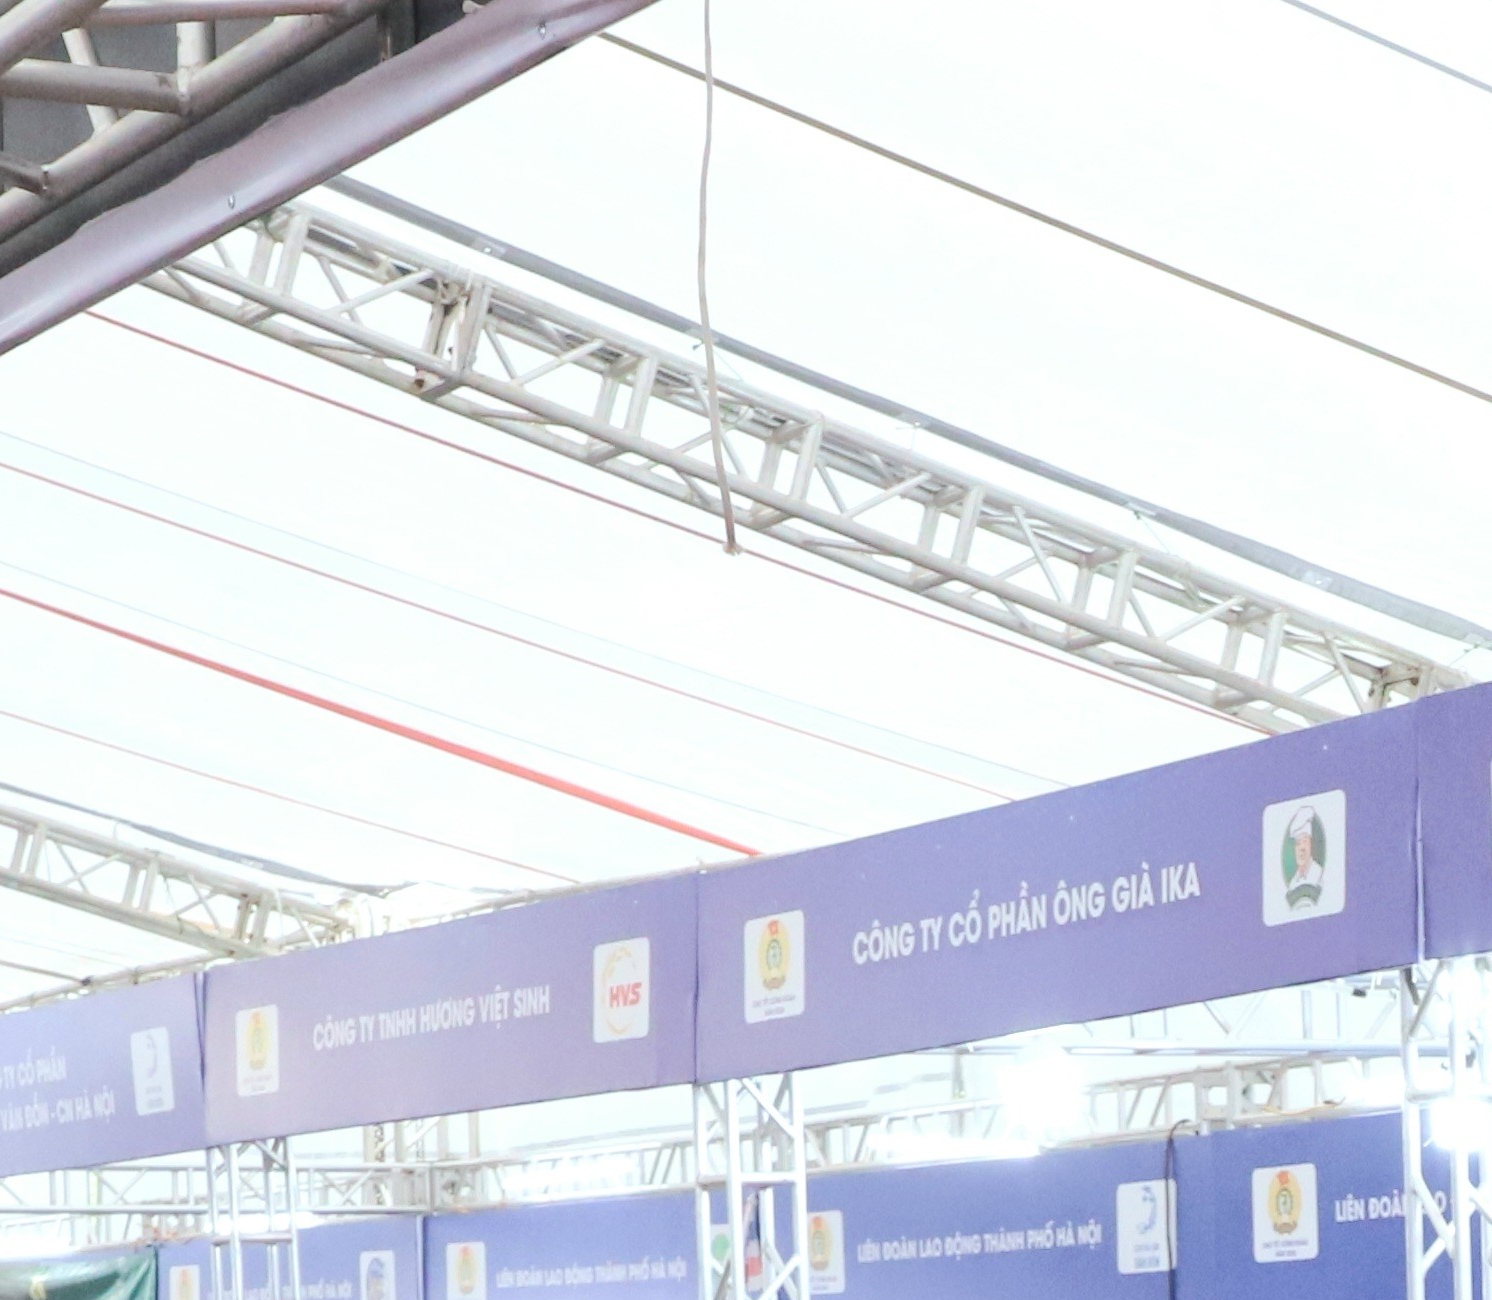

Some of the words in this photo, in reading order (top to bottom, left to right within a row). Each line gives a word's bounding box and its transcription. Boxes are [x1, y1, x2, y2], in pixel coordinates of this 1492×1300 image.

[852, 921, 916, 965] CÔNG
[919, 918, 944, 952] TY
[948, 890, 983, 946] CỔ
[987, 880, 1048, 940] PHẦN
[1053, 872, 1106, 927] ÔNG
[1112, 862, 1155, 912] GIÀ
[1159, 863, 1201, 904] IKA
[609, 982, 642, 1009] HVS
[313, 1018, 357, 1053] CÔNG
[359, 1016, 375, 1044] TY
[379, 1003, 417, 1041] TNHH
[513, 984, 551, 1021] SINH
[1335, 1193, 1365, 1223] LIÊN
[918, 1237, 942, 1258] LAO
